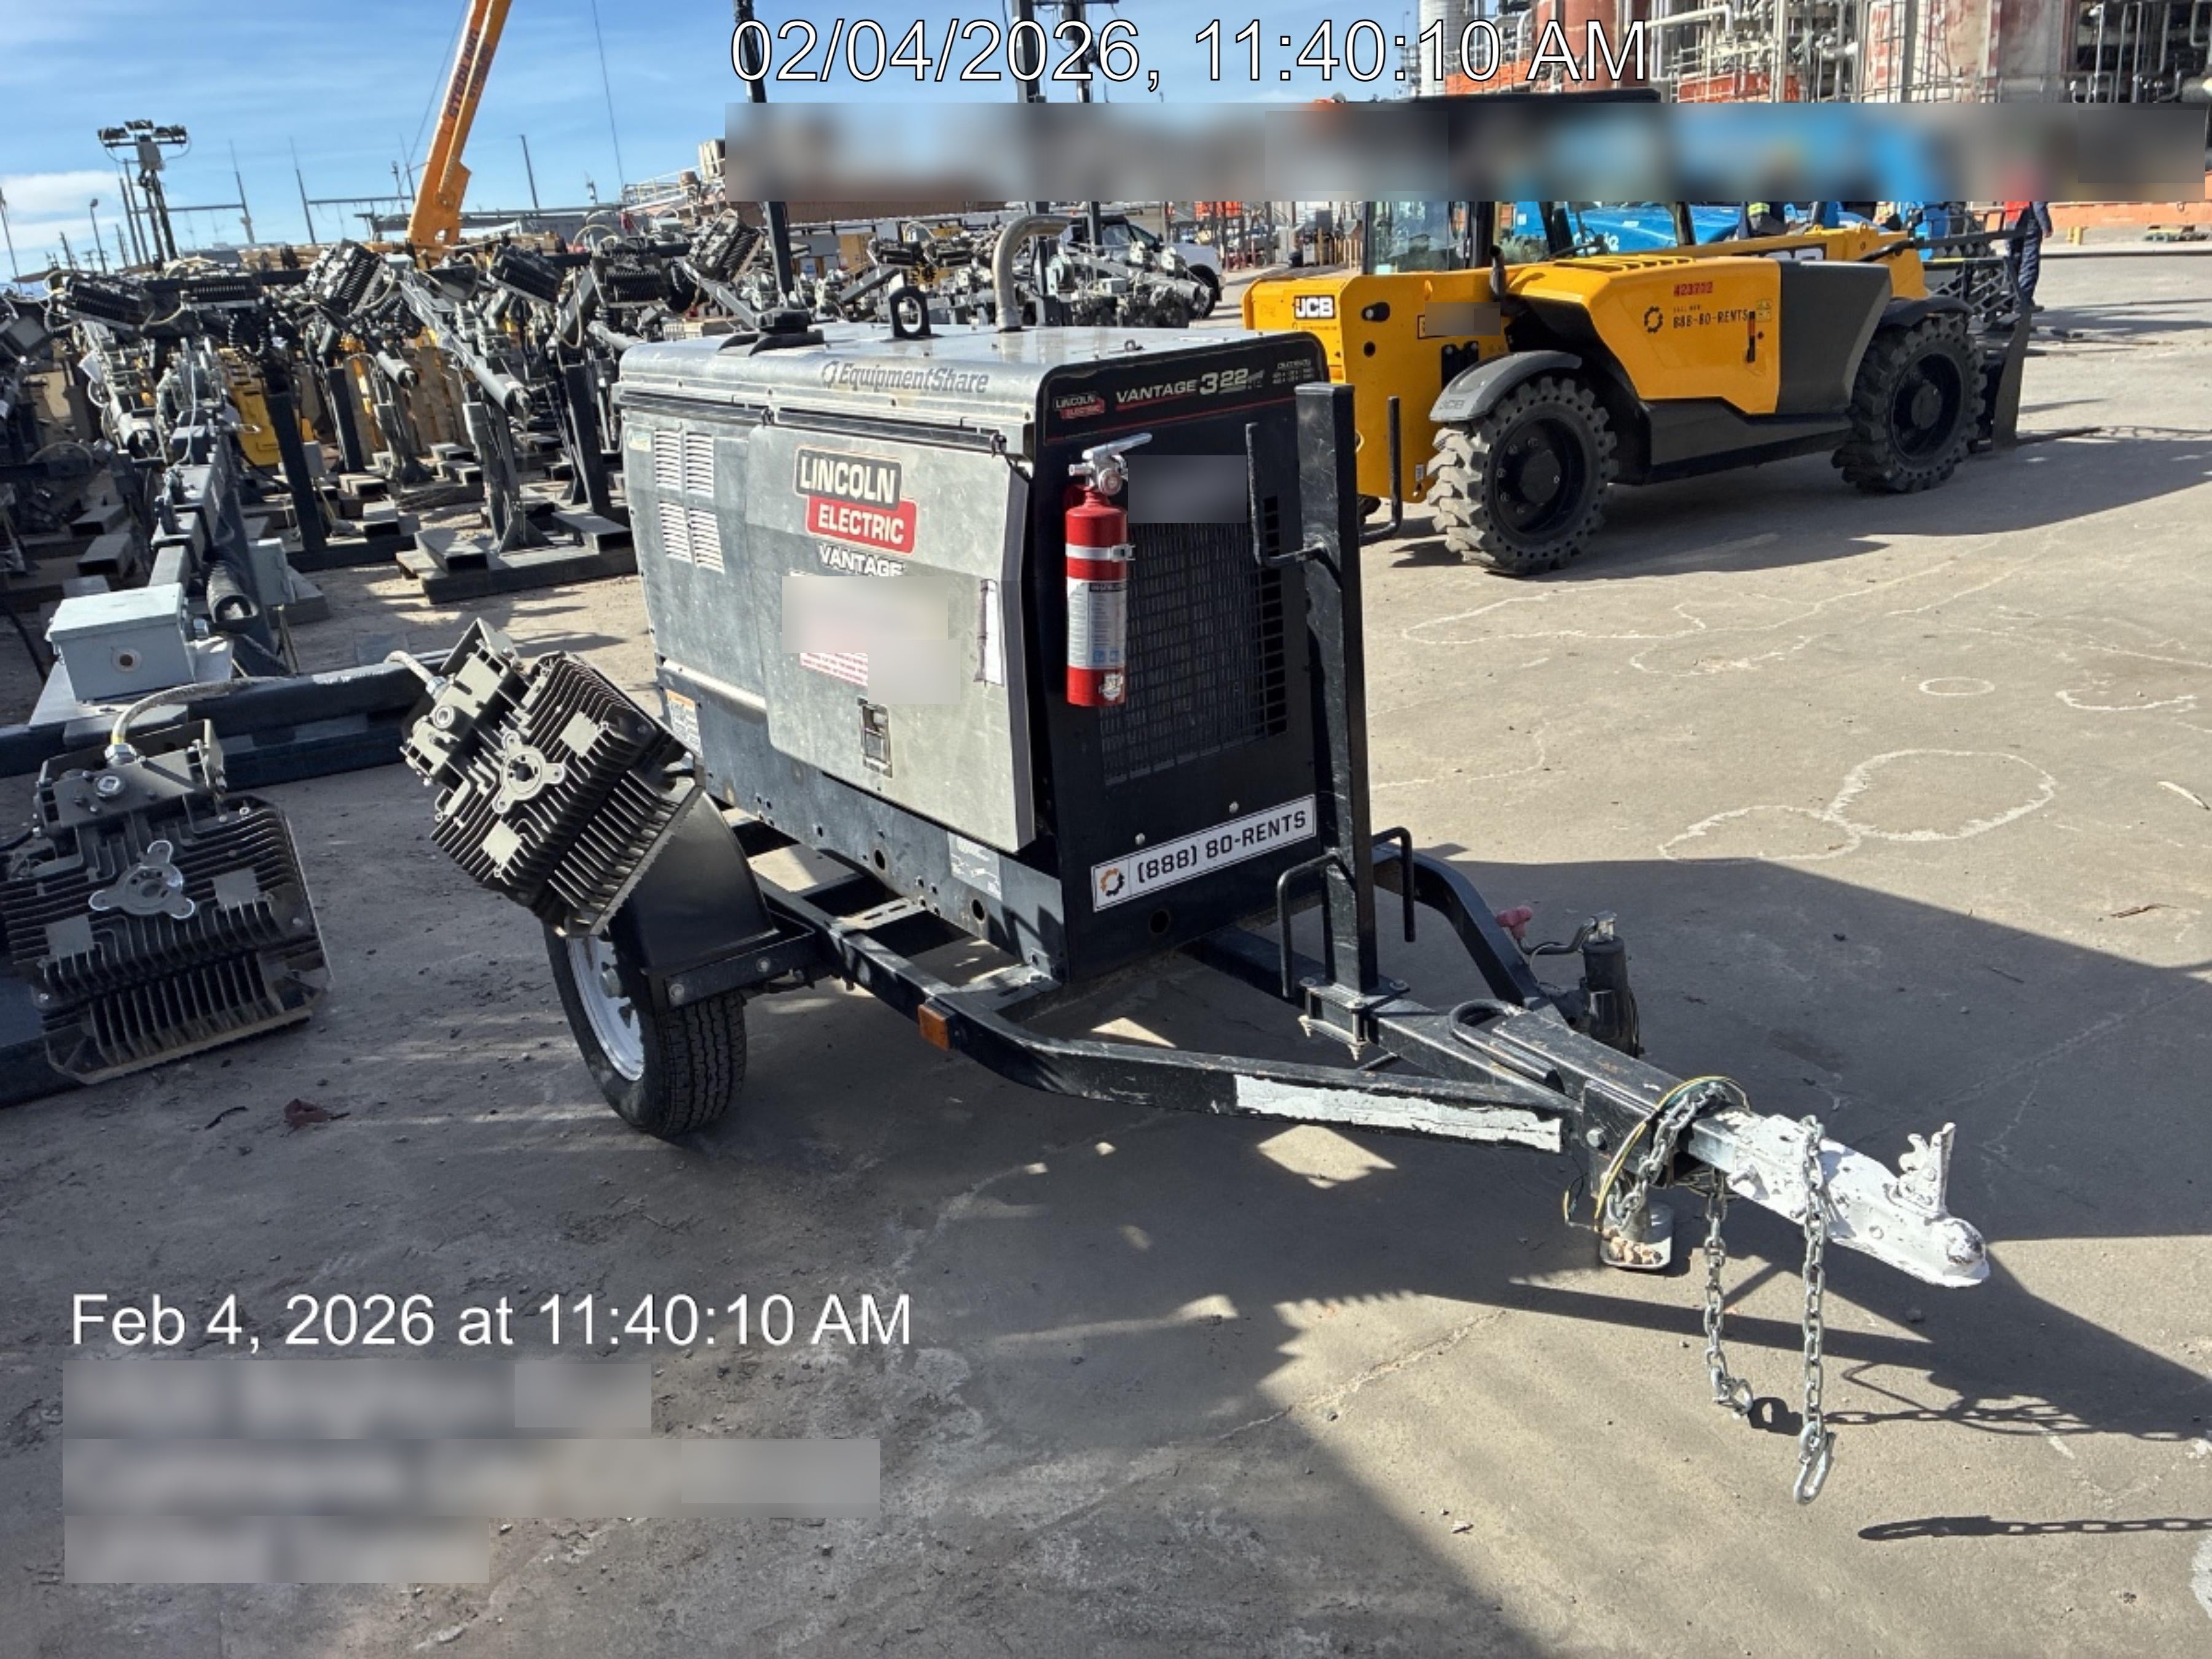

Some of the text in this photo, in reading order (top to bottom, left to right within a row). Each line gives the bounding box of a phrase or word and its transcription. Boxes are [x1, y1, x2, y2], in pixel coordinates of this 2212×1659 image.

[1295, 296, 1335, 319] JCB
[838, 363, 989, 393] EquipmentShare
[1116, 380, 1198, 403] VANTAGE
[1199, 367, 1249, 395] 322
[1055, 395, 1096, 409] LINCOLN
[799, 456, 895, 504] LINCOLN
[818, 503, 904, 544] ELECTRIC
[818, 545, 903, 576] VANTAGE
[1137, 810, 1306, 883] (888) 80-RENTS
